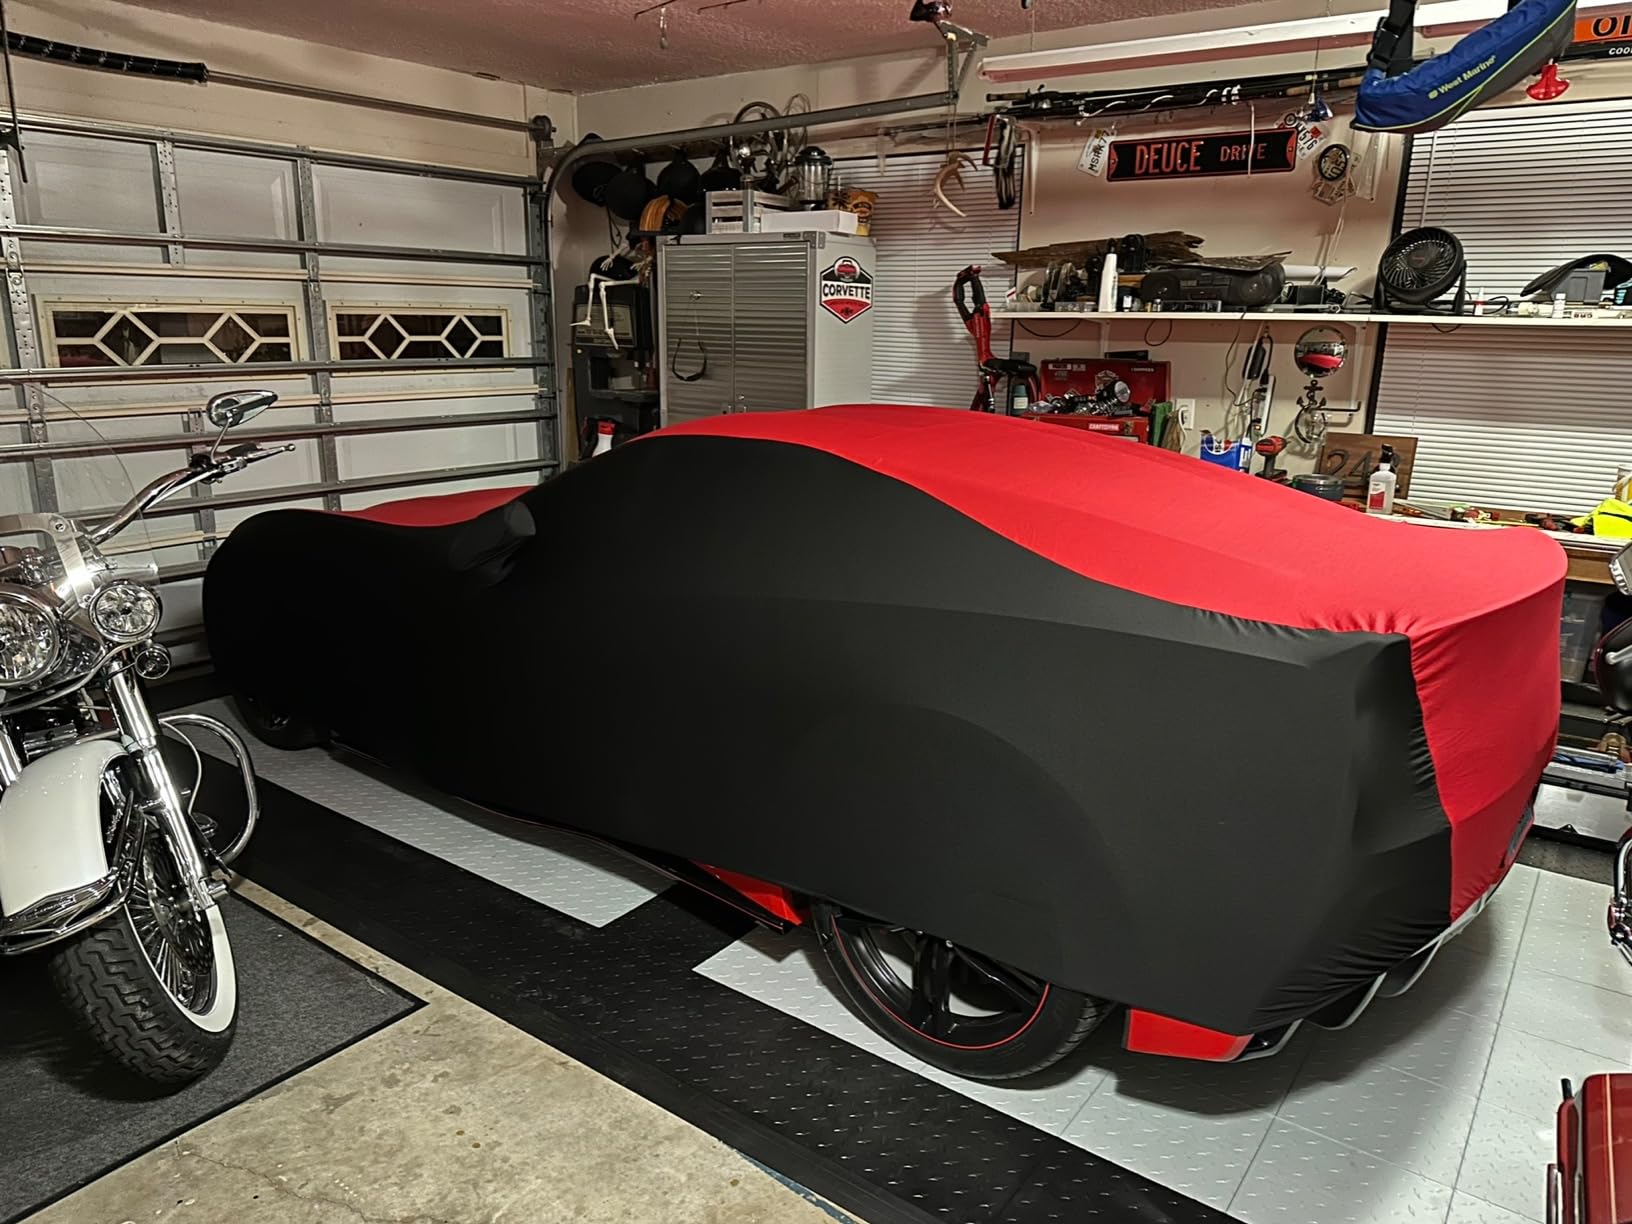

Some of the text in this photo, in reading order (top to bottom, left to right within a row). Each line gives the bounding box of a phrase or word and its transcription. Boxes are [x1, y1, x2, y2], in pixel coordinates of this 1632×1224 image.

[1438, 76, 1463, 94] West
[1134, 141, 1202, 175] DEUCE
[822, 283, 871, 300] CORVETTE
